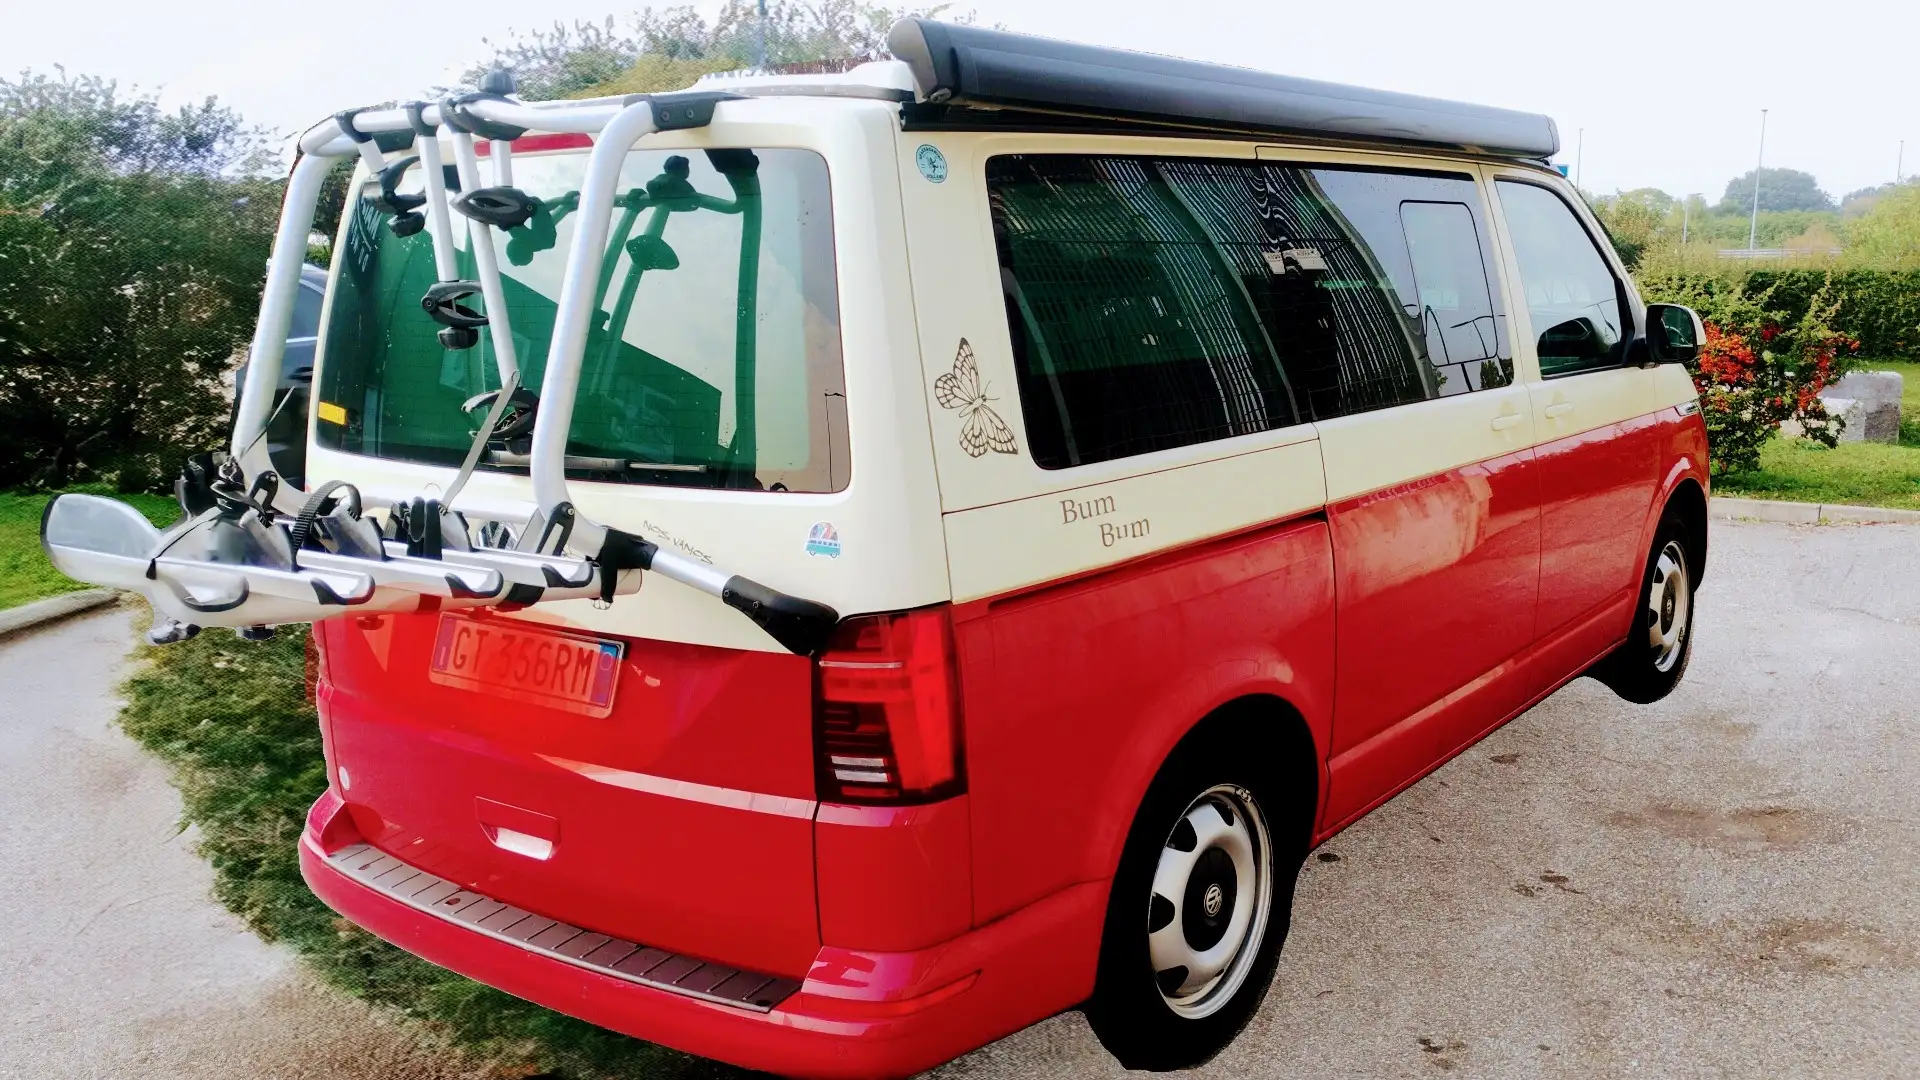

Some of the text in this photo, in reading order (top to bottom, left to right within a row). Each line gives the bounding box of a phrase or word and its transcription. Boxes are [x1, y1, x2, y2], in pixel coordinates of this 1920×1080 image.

[1059, 496, 1116, 524] Bum
[643, 520, 671, 541] NOS
[1099, 518, 1150, 547] Bum
[452, 626, 597, 696] GT 356RM
